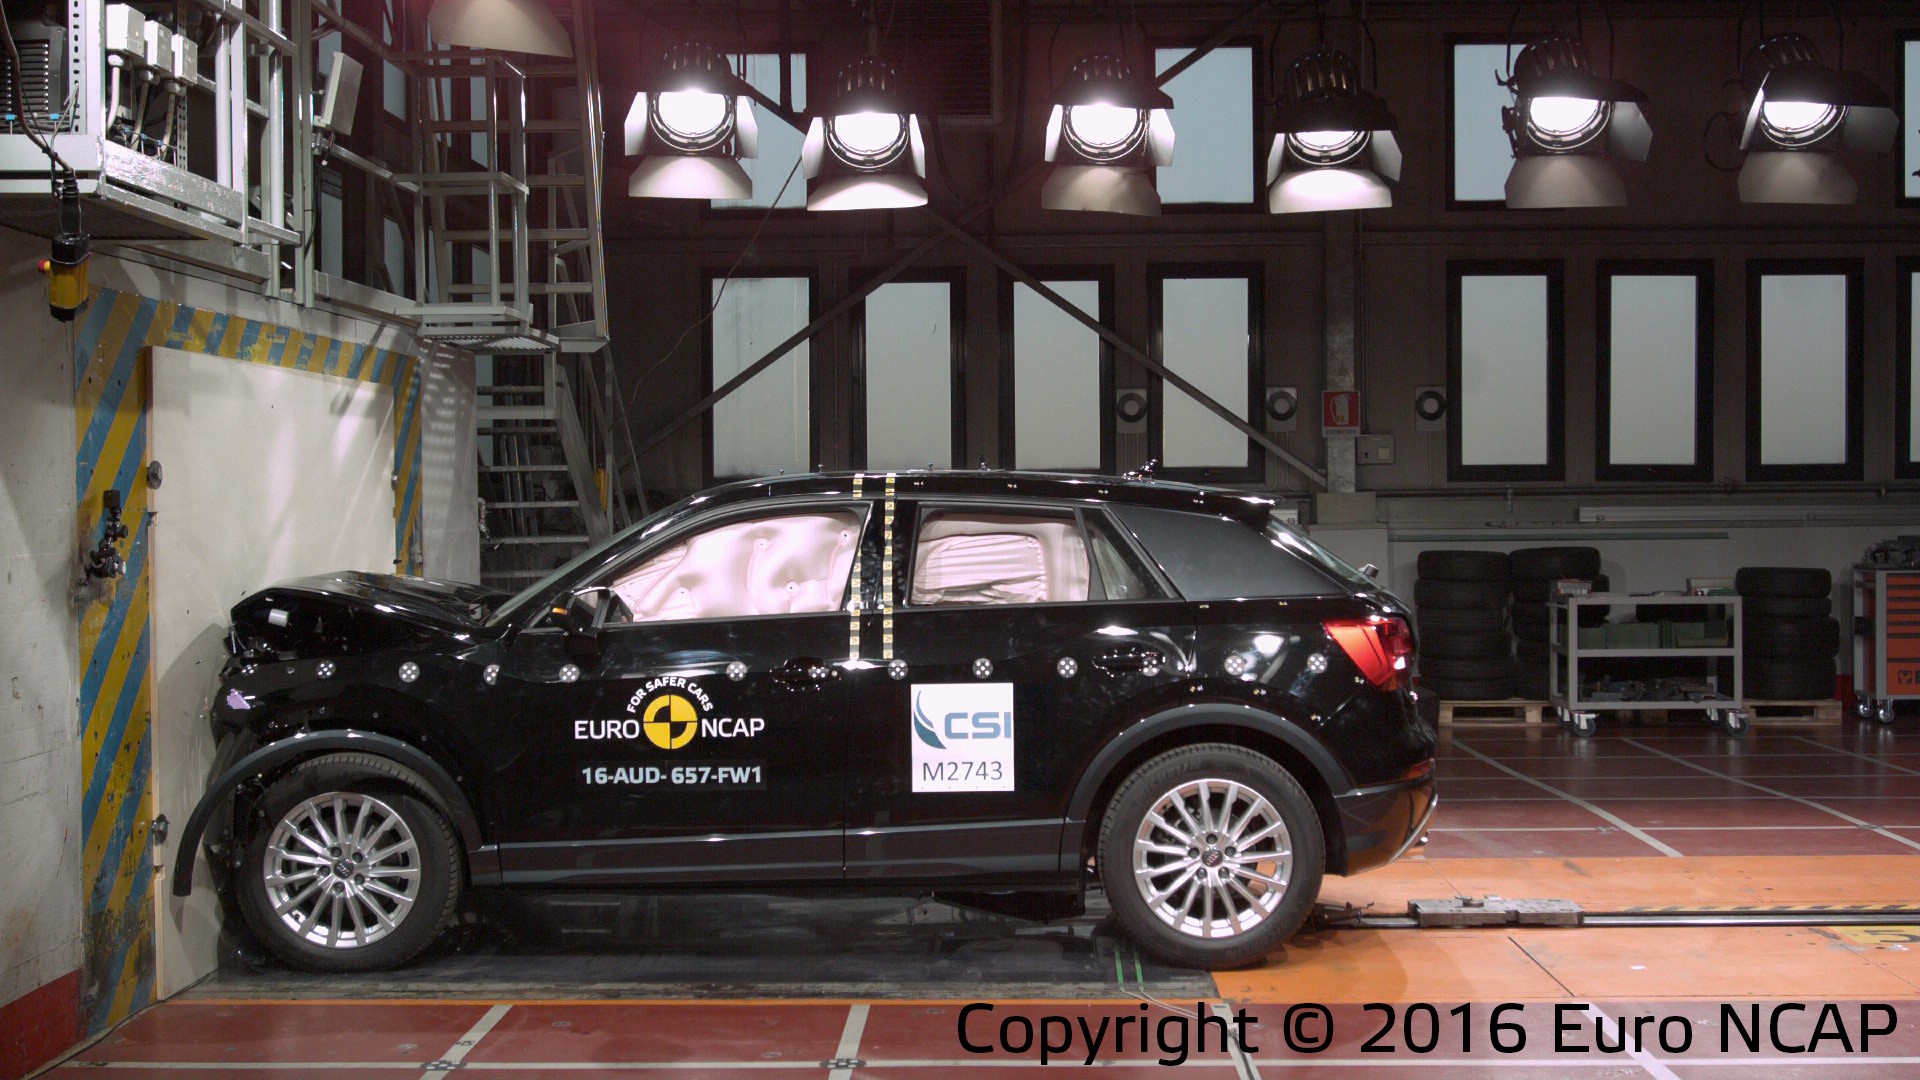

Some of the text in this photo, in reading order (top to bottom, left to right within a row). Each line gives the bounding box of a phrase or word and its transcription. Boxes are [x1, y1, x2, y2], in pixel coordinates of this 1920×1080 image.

[626, 676, 714, 713] FOR SAFER CARS
[574, 717, 765, 739] EURO NCAP
[944, 712, 1012, 739] CSI
[922, 761, 1003, 781] M2743
